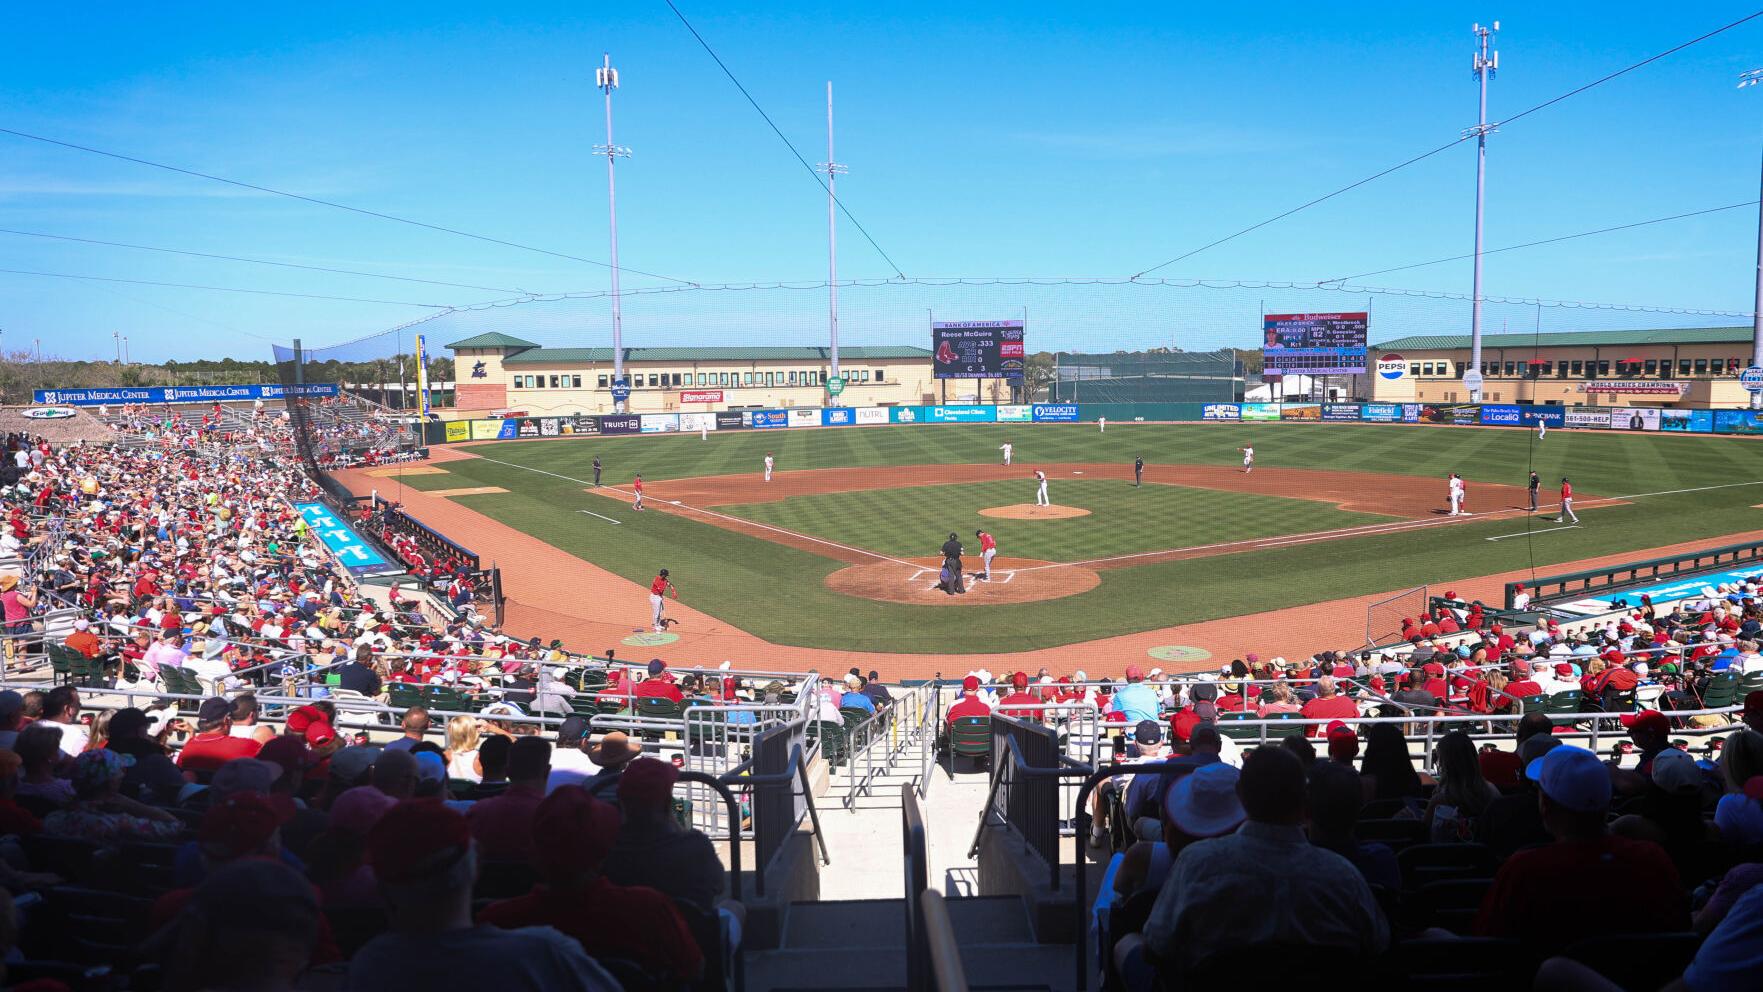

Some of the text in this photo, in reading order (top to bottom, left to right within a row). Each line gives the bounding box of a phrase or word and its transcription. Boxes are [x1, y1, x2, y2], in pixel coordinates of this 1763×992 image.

[57, 391, 150, 401] JUPITER MEDICAL CENTER
[174, 389, 198, 399] JUPITER
[199, 388, 226, 397] MEDICAL
[683, 393, 721, 401] Signarama
[1491, 413, 1520, 421] LocaliQ
